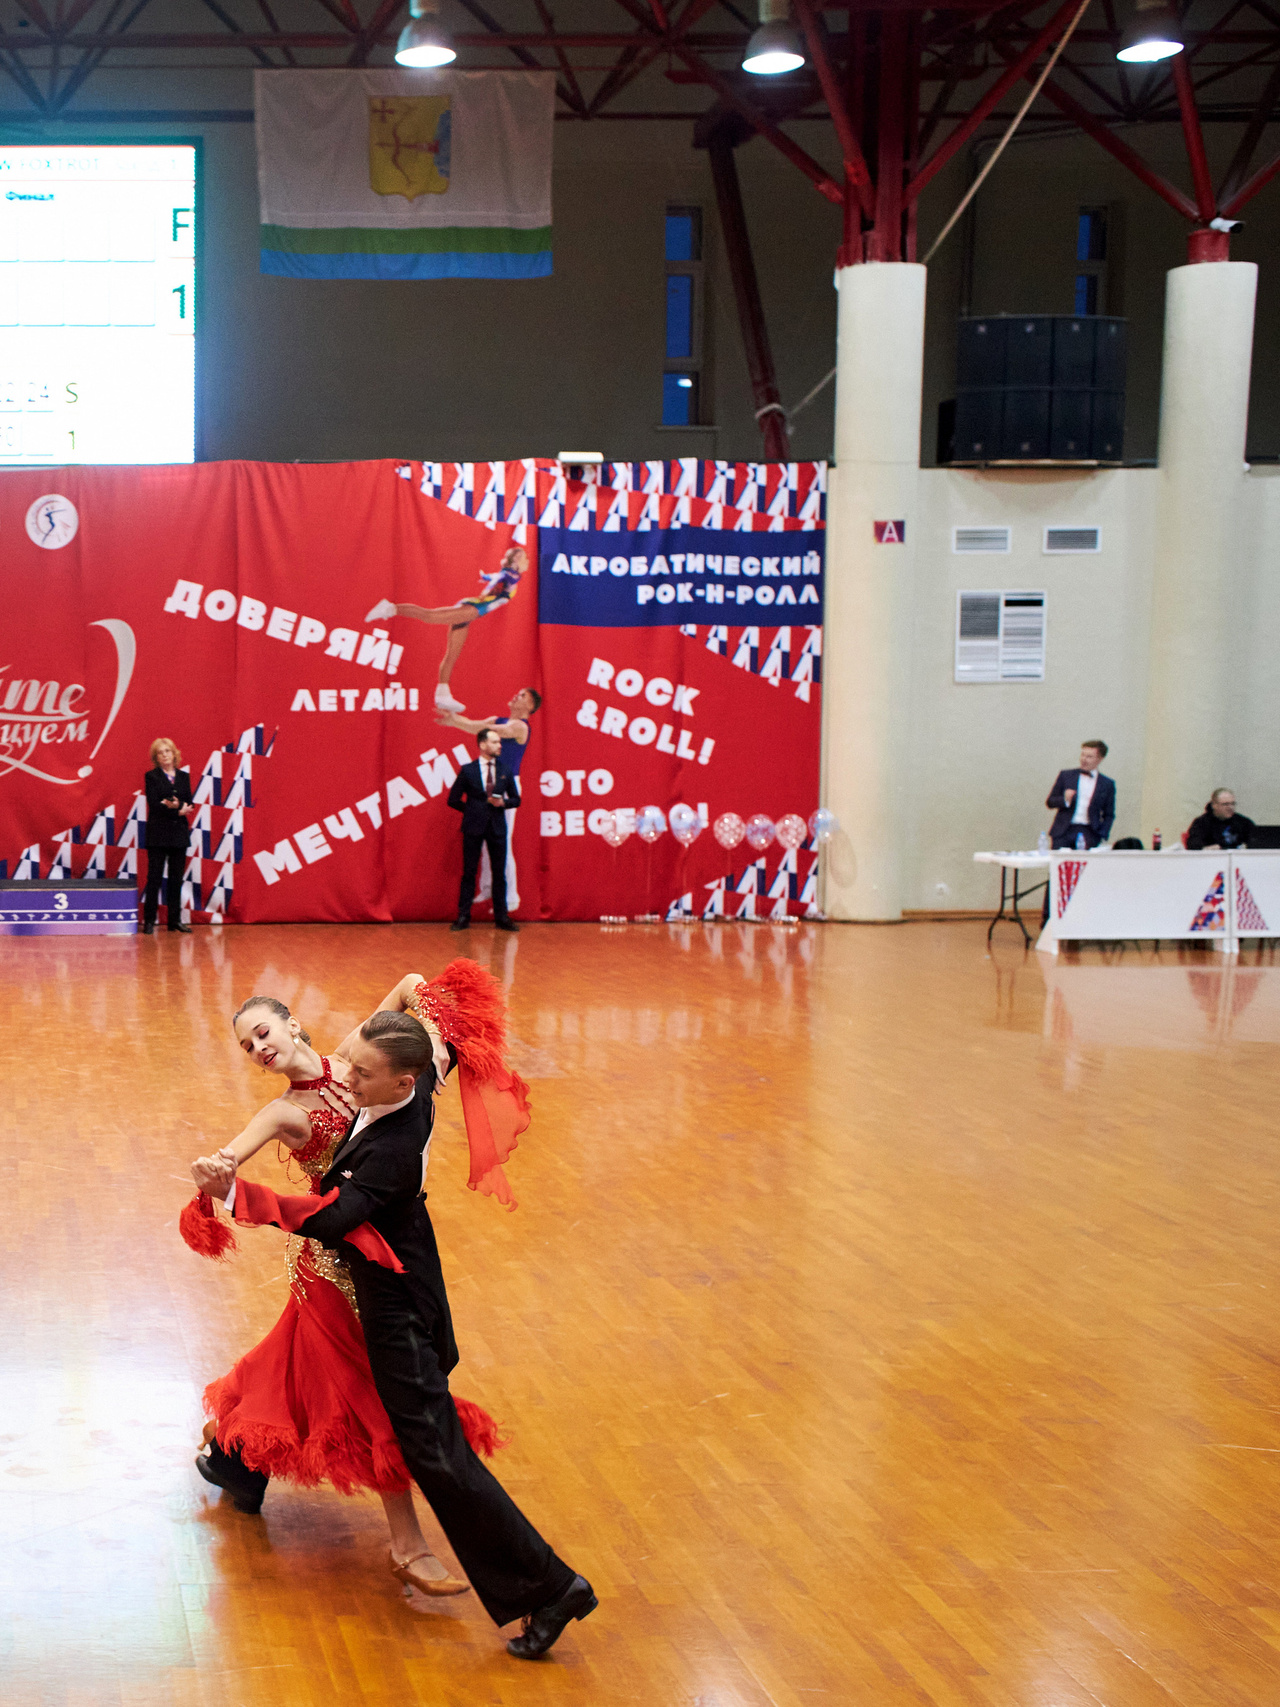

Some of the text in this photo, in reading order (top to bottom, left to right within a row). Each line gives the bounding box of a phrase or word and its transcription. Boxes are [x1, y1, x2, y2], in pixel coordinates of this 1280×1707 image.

[172, 285, 186, 319] 1
[65, 382, 80, 404] S
[552, 550, 821, 577] АКРОБАТИЧЕСКИЙ
[636, 582, 820, 606] РОК-Н-РОЛЛ
[163, 579, 404, 675] ДОВЕРЯЙ!
[290, 681, 420, 712] ЛЕТАЙ!
[587, 657, 701, 717] ROCK
[576, 698, 716, 766] &ROLL!
[539, 768, 615, 798] ЭТО
[253, 744, 473, 886] МЕЧТАЙ!
[539, 802, 710, 838] ВЕСЕЛО!
[53, 892, 69, 911] 3
